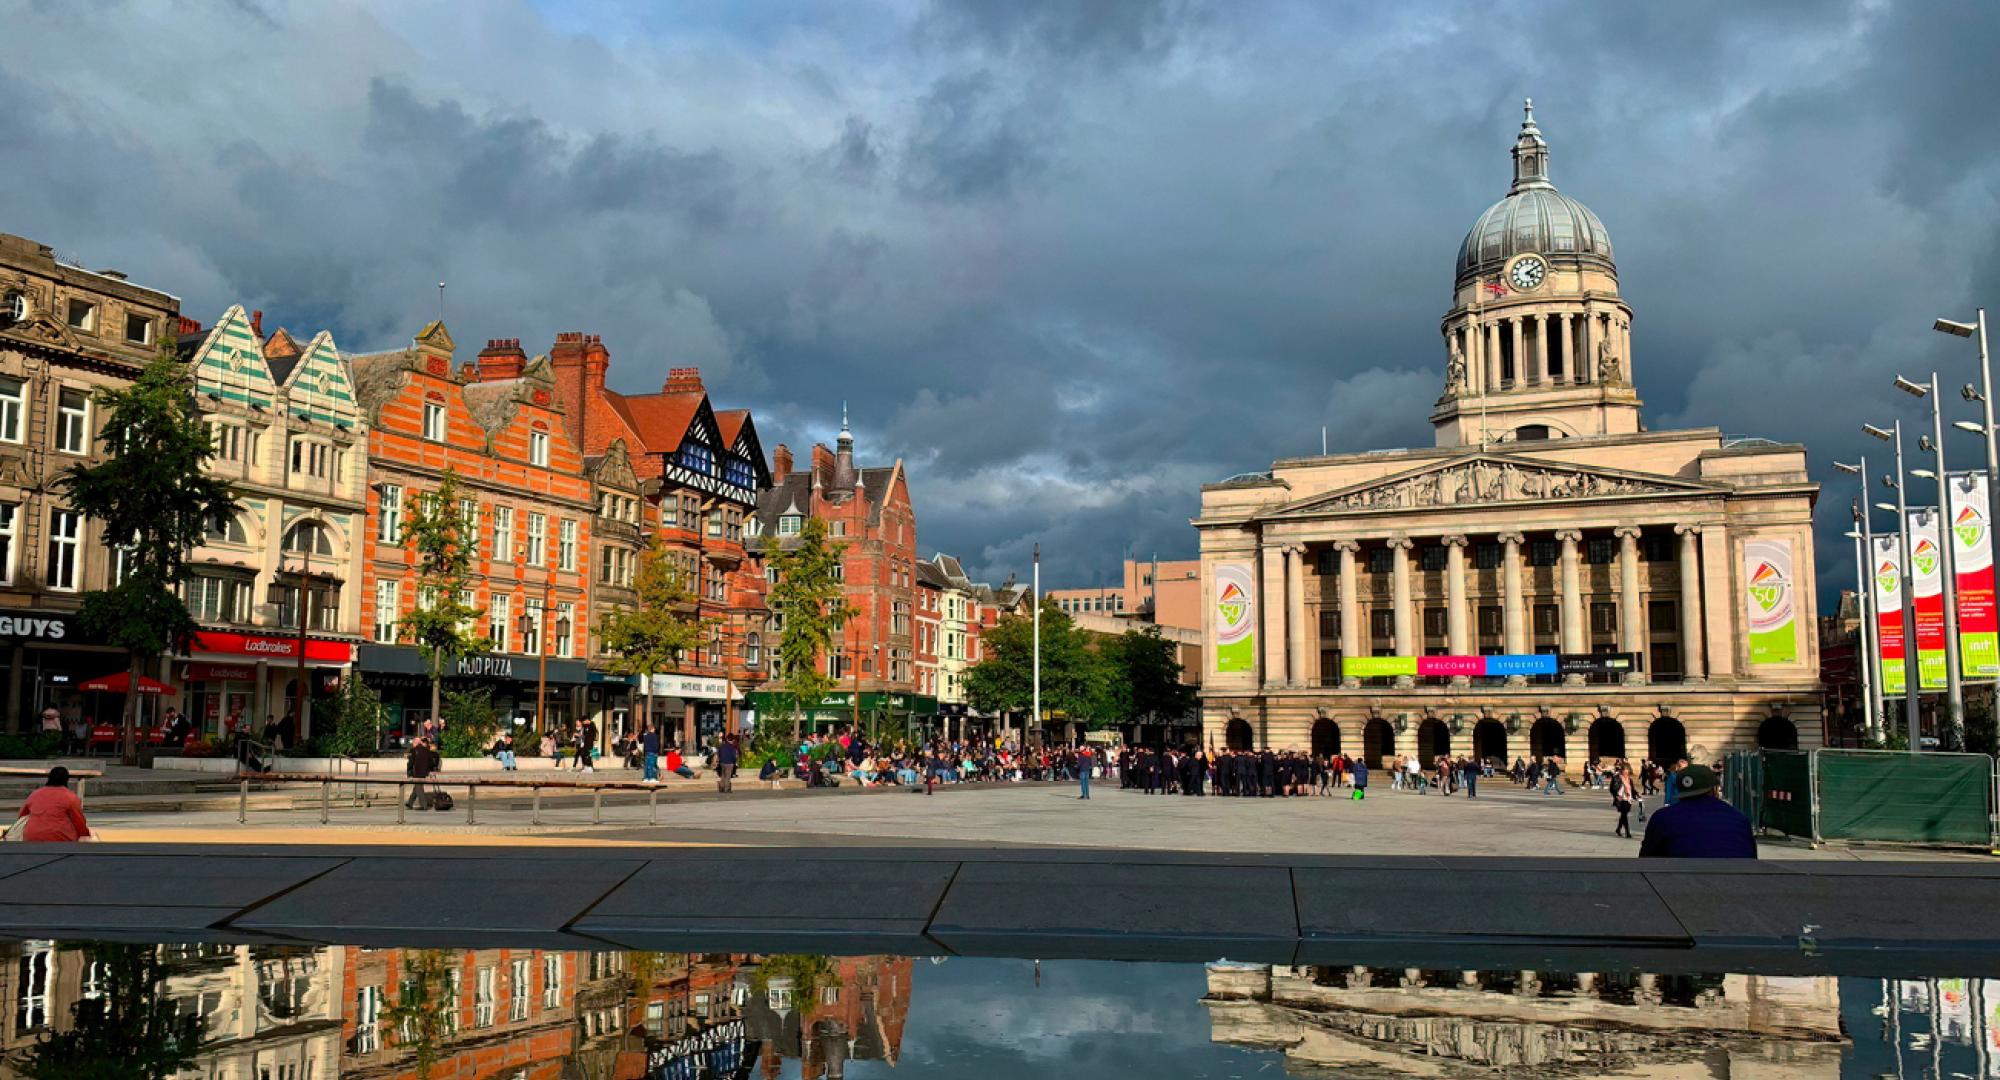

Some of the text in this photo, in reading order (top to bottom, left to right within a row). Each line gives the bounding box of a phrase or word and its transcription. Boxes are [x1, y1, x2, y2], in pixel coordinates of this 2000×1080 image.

[0, 616, 65, 639] GUYS
[245, 640, 292, 654] Ladbrokes
[484, 658, 513, 678] PIZZA
[1497, 661, 1545, 669] STUDENTS
